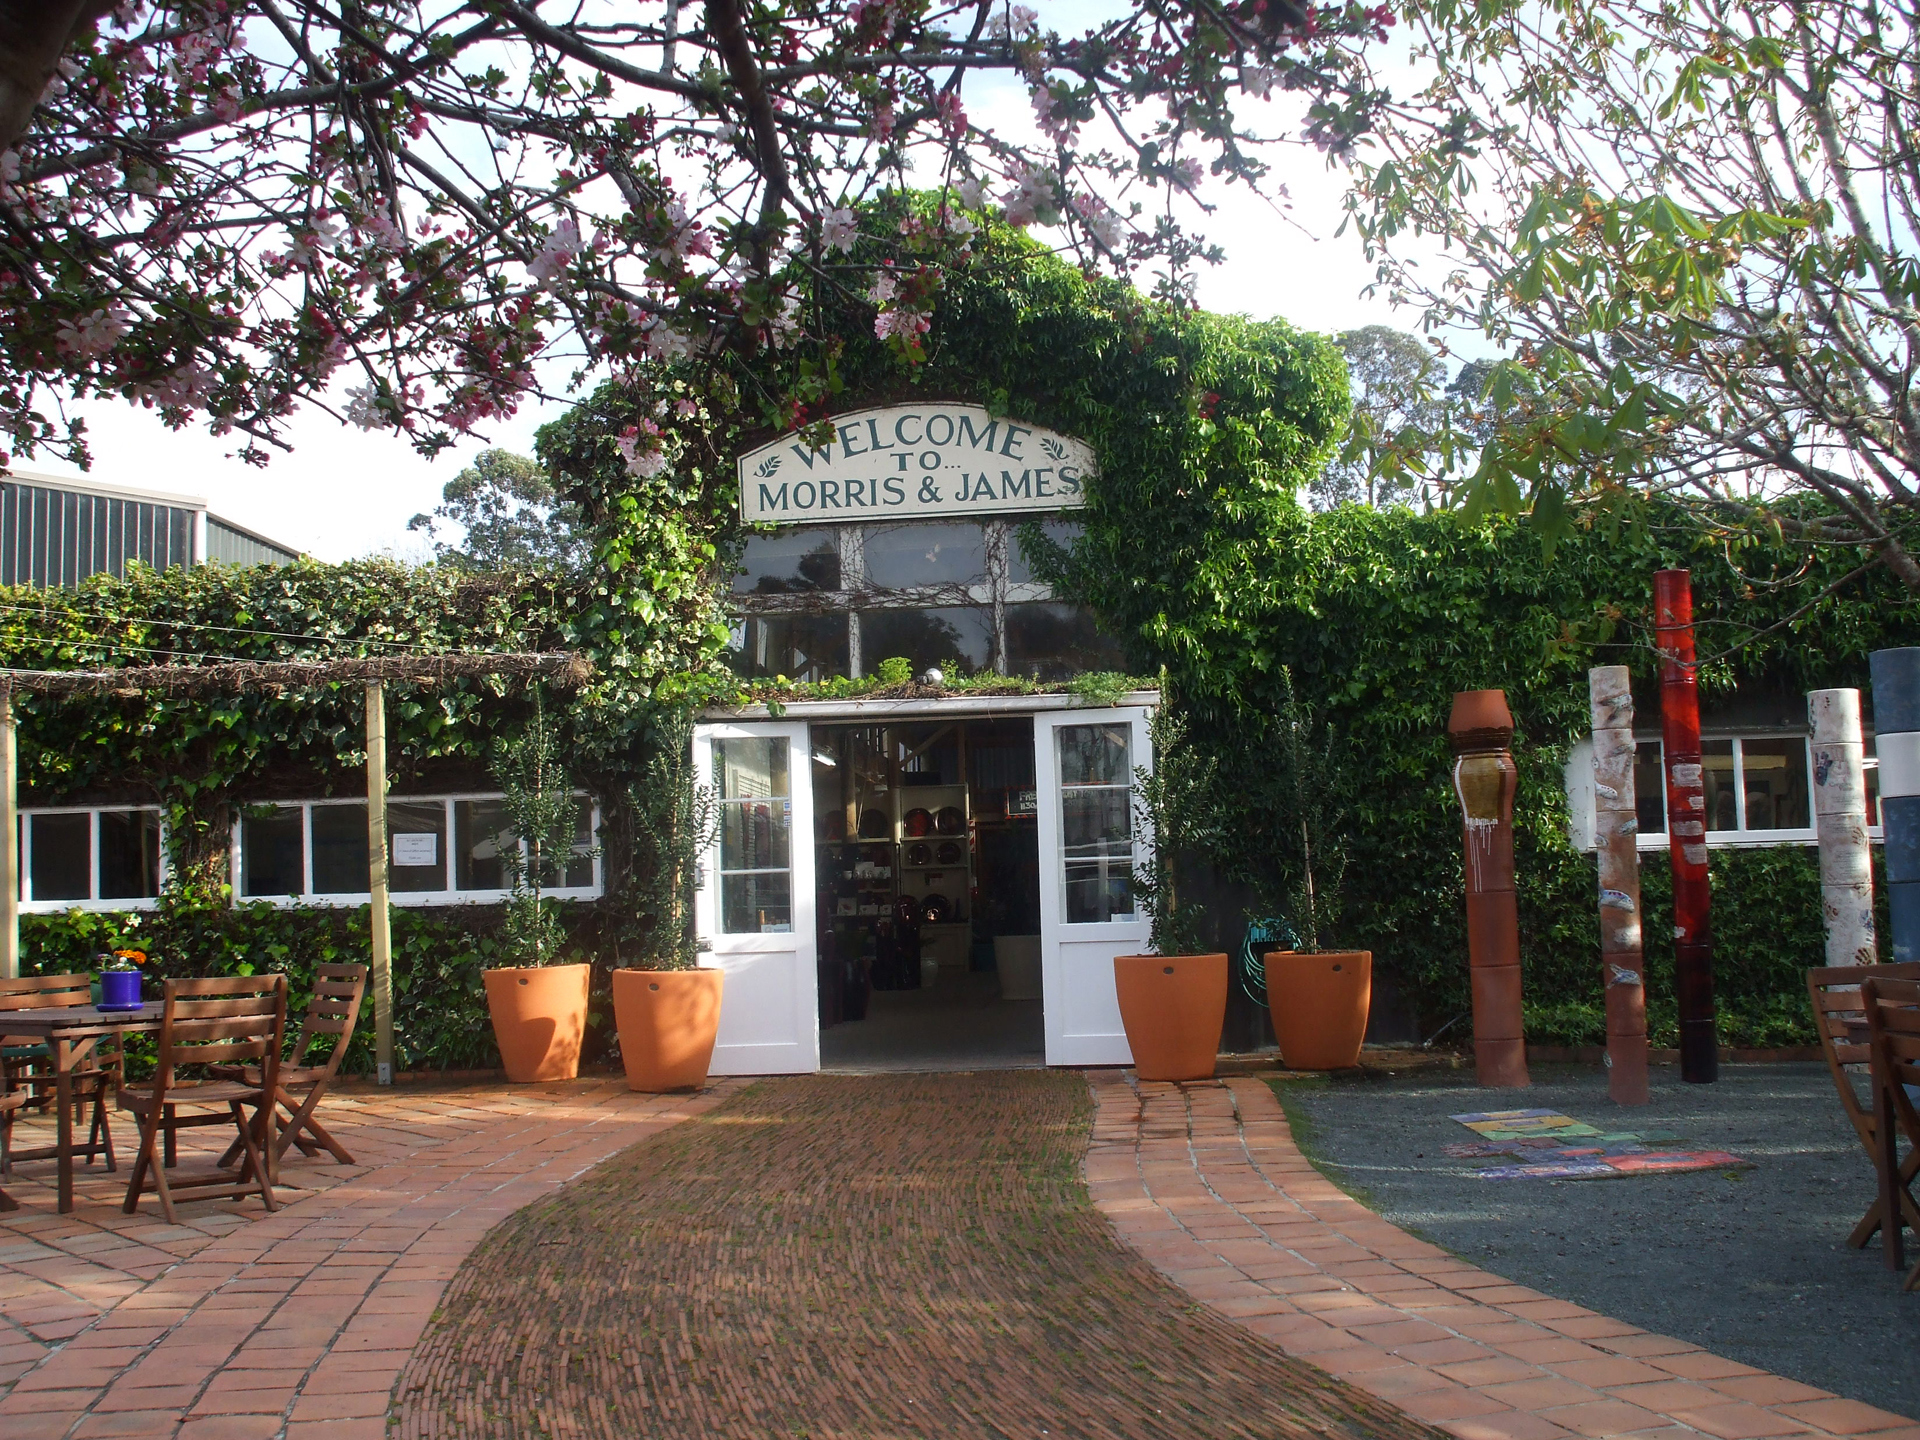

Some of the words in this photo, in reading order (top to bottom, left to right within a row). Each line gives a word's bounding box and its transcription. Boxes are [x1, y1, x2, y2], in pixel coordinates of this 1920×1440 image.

[789, 414, 1033, 470] WELCOME
[758, 476, 906, 512] MORRIS
[917, 475, 944, 504] &
[954, 465, 1081, 502] JAMES
